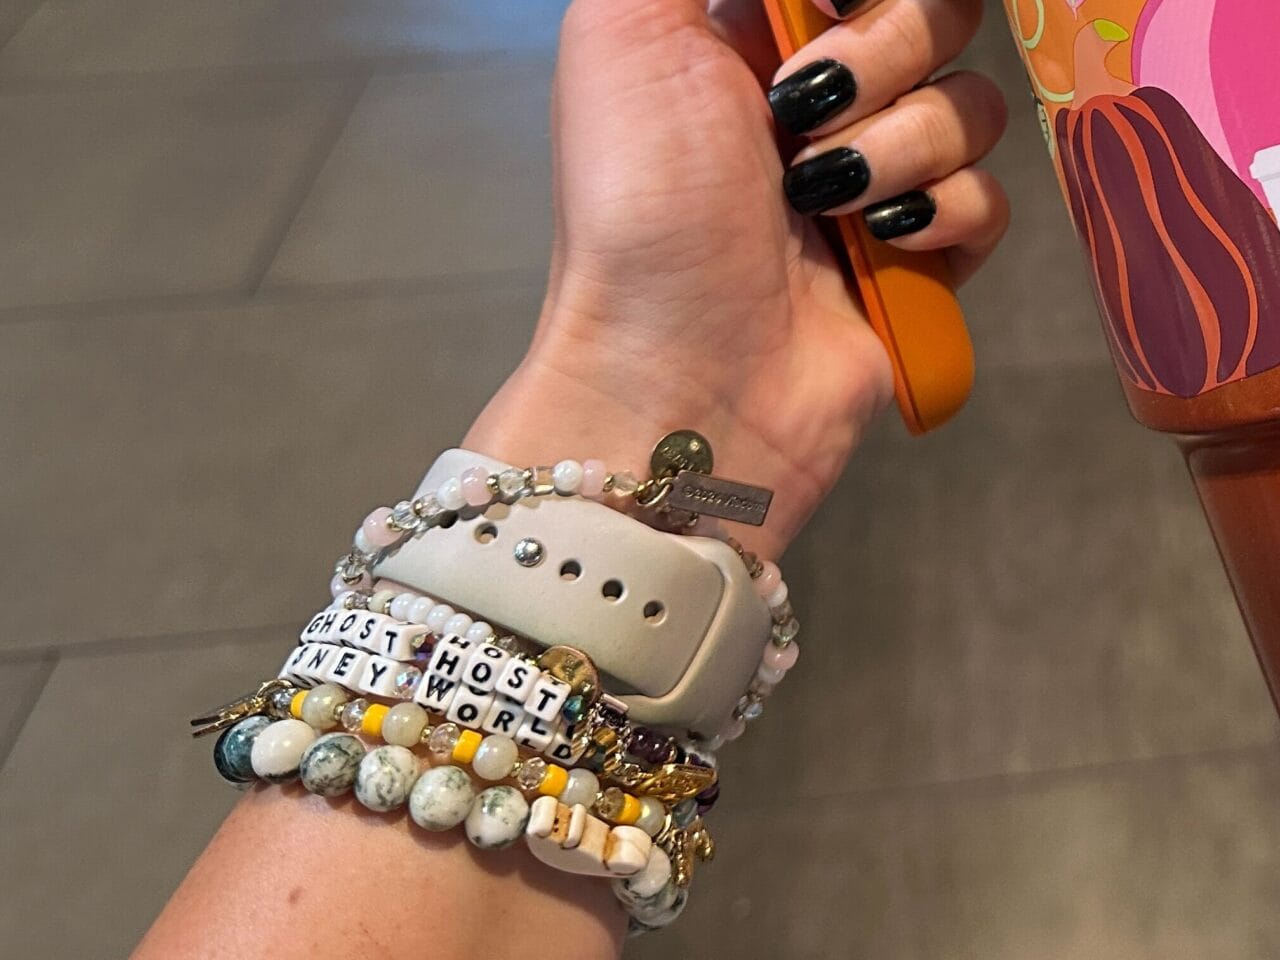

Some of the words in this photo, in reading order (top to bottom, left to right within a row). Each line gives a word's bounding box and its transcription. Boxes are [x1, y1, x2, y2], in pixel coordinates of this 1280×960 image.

[306, 612, 398, 654] GHOST
[435, 649, 558, 712] HOST
[425, 674, 573, 760] WORLD
